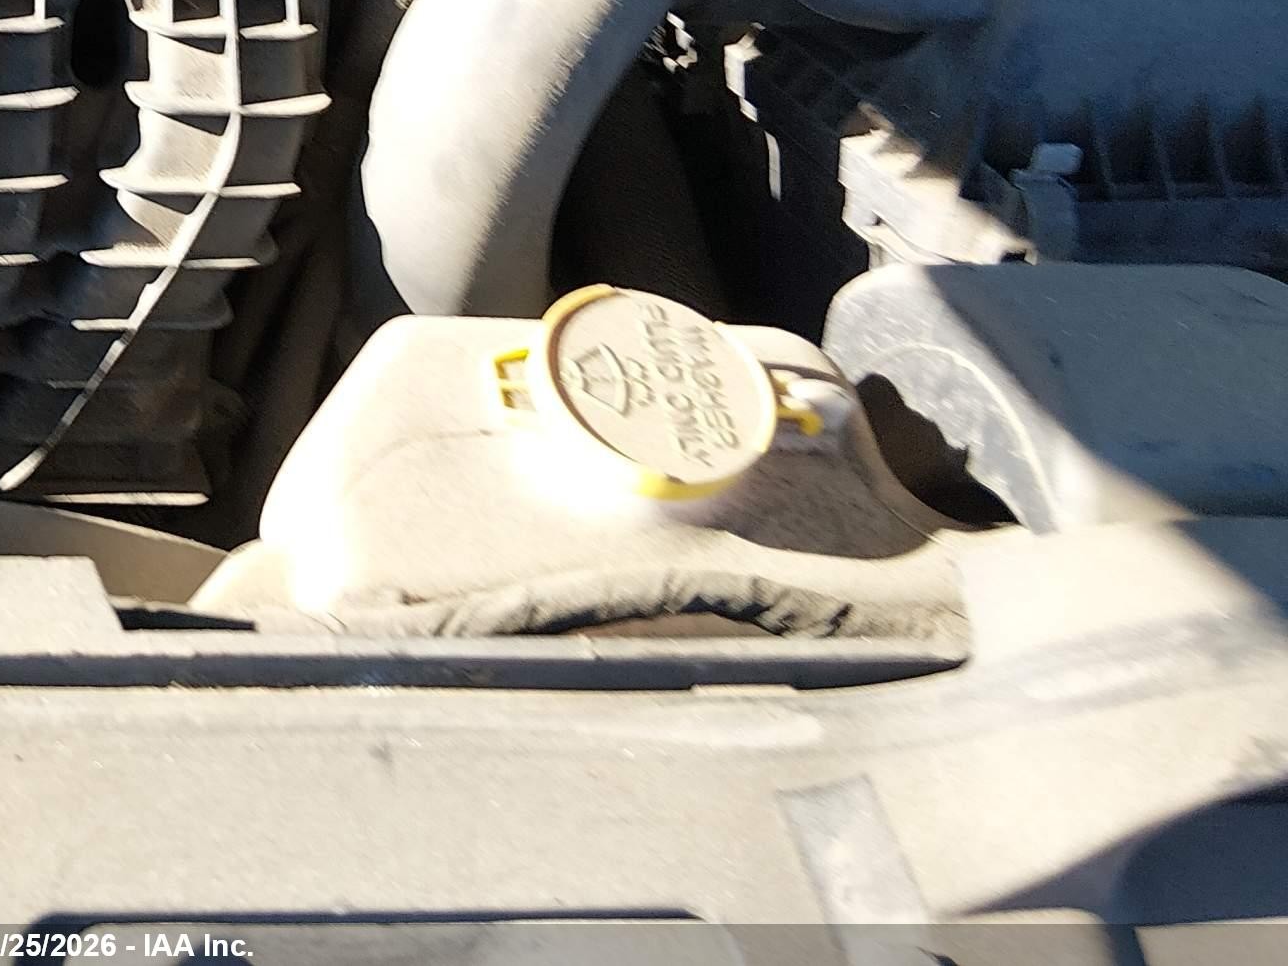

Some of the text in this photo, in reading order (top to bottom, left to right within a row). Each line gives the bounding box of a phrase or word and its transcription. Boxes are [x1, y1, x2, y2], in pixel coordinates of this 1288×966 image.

[636, 300, 714, 468] FLUID ONLY
[680, 323, 741, 451] WASHER
